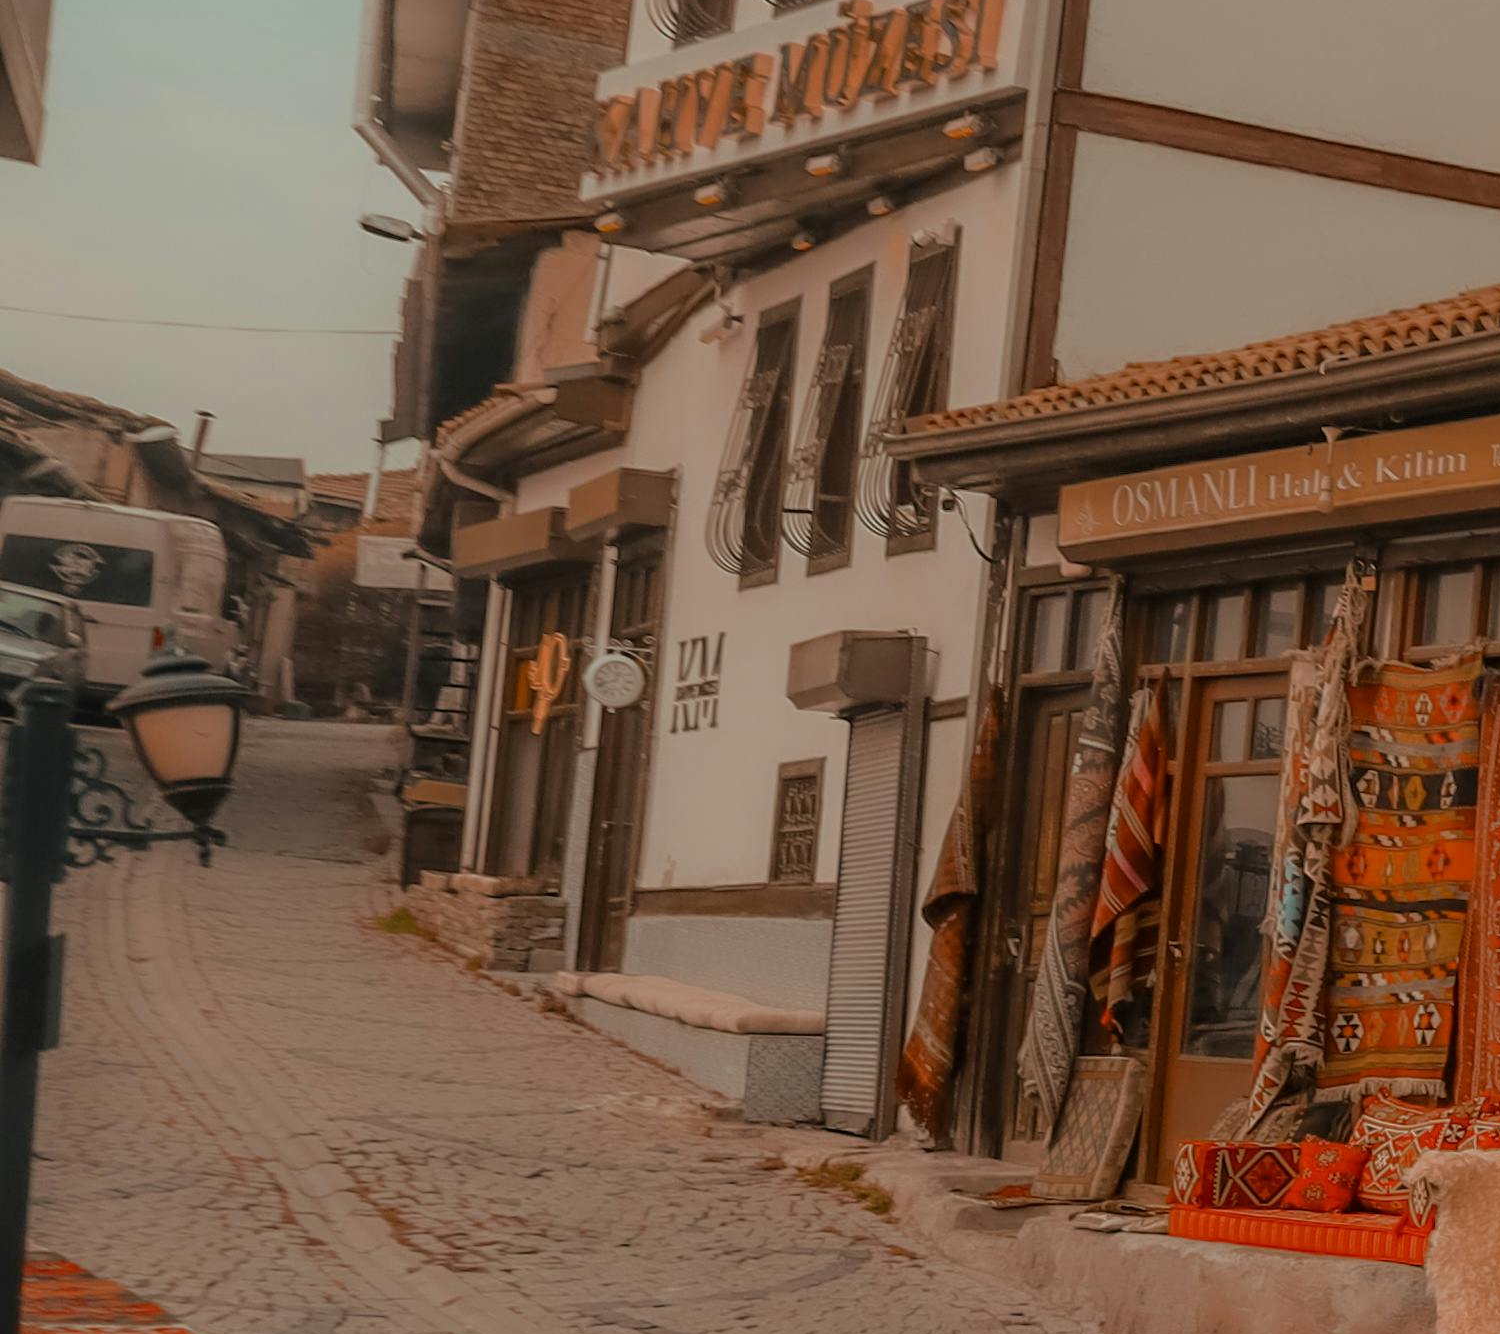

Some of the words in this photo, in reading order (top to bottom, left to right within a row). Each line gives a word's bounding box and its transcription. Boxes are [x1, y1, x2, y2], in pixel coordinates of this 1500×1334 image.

[1112, 465, 1258, 526] OSMANLI
[1268, 469, 1330, 500] Hal
[1337, 462, 1362, 491] &
[1375, 450, 1468, 483] Kilim
